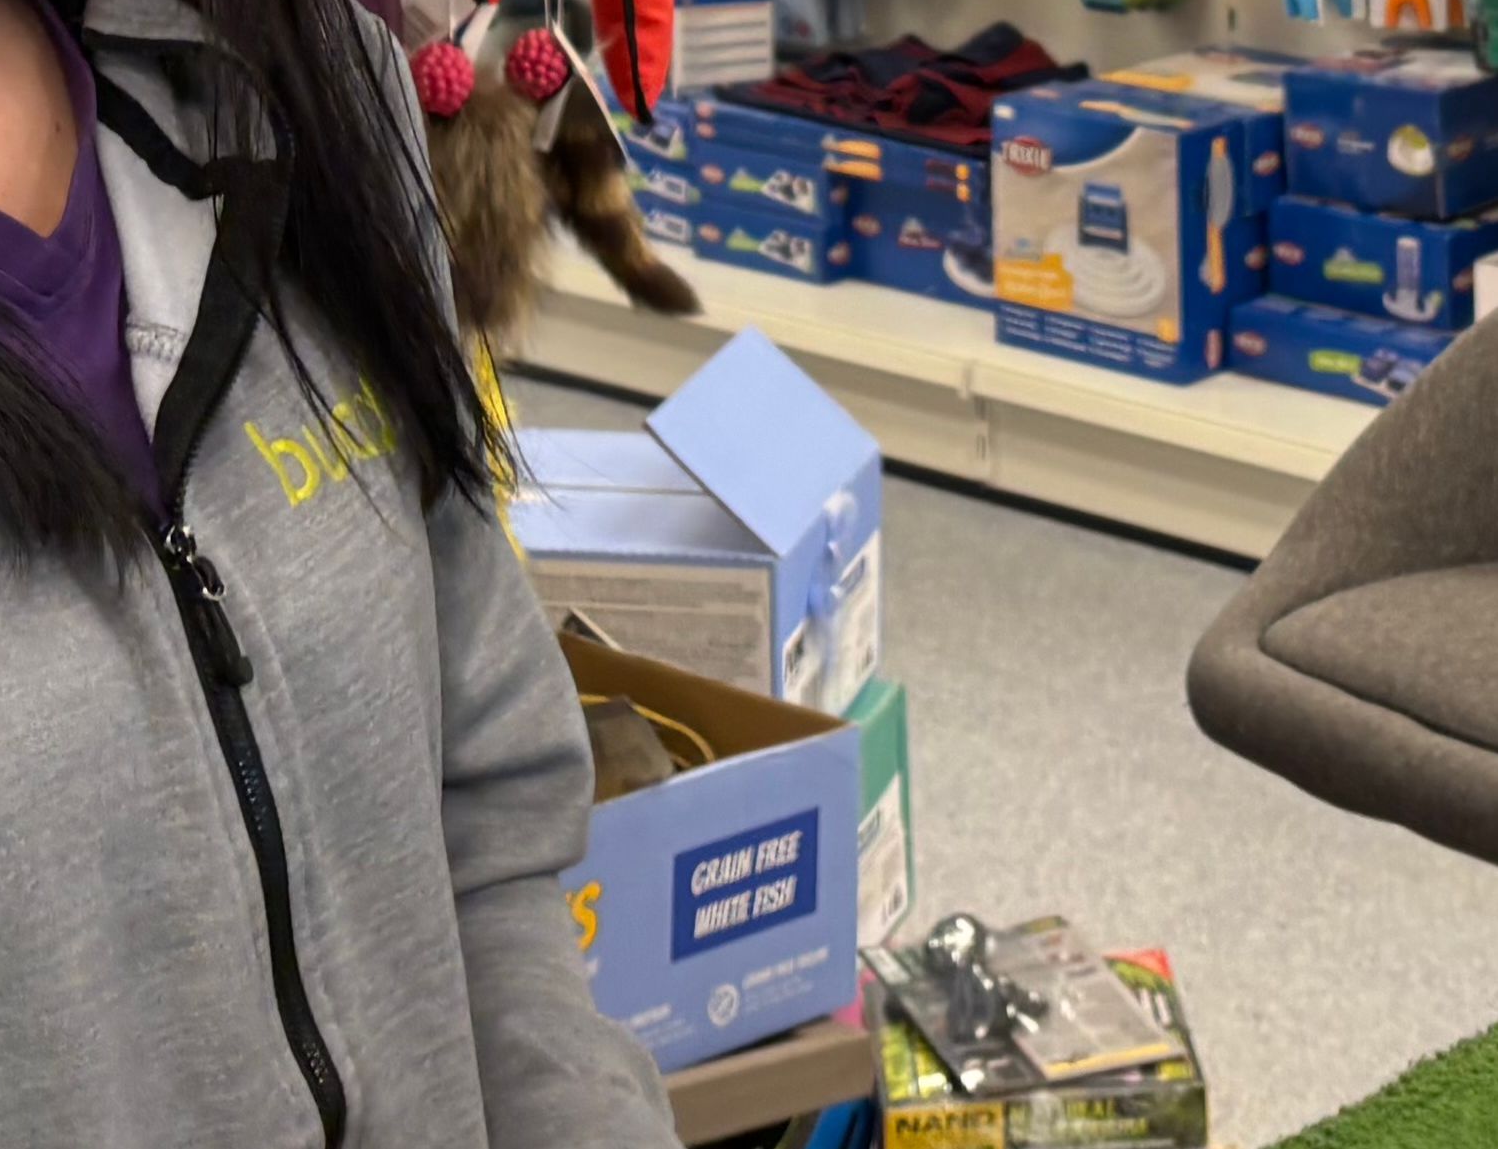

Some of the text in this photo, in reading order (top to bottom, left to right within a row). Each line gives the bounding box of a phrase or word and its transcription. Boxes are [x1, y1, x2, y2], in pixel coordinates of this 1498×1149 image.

[244, 374, 396, 509] bud
[691, 829, 803, 897] GRAIN FREE
[693, 874, 798, 940] WHITE FISH
